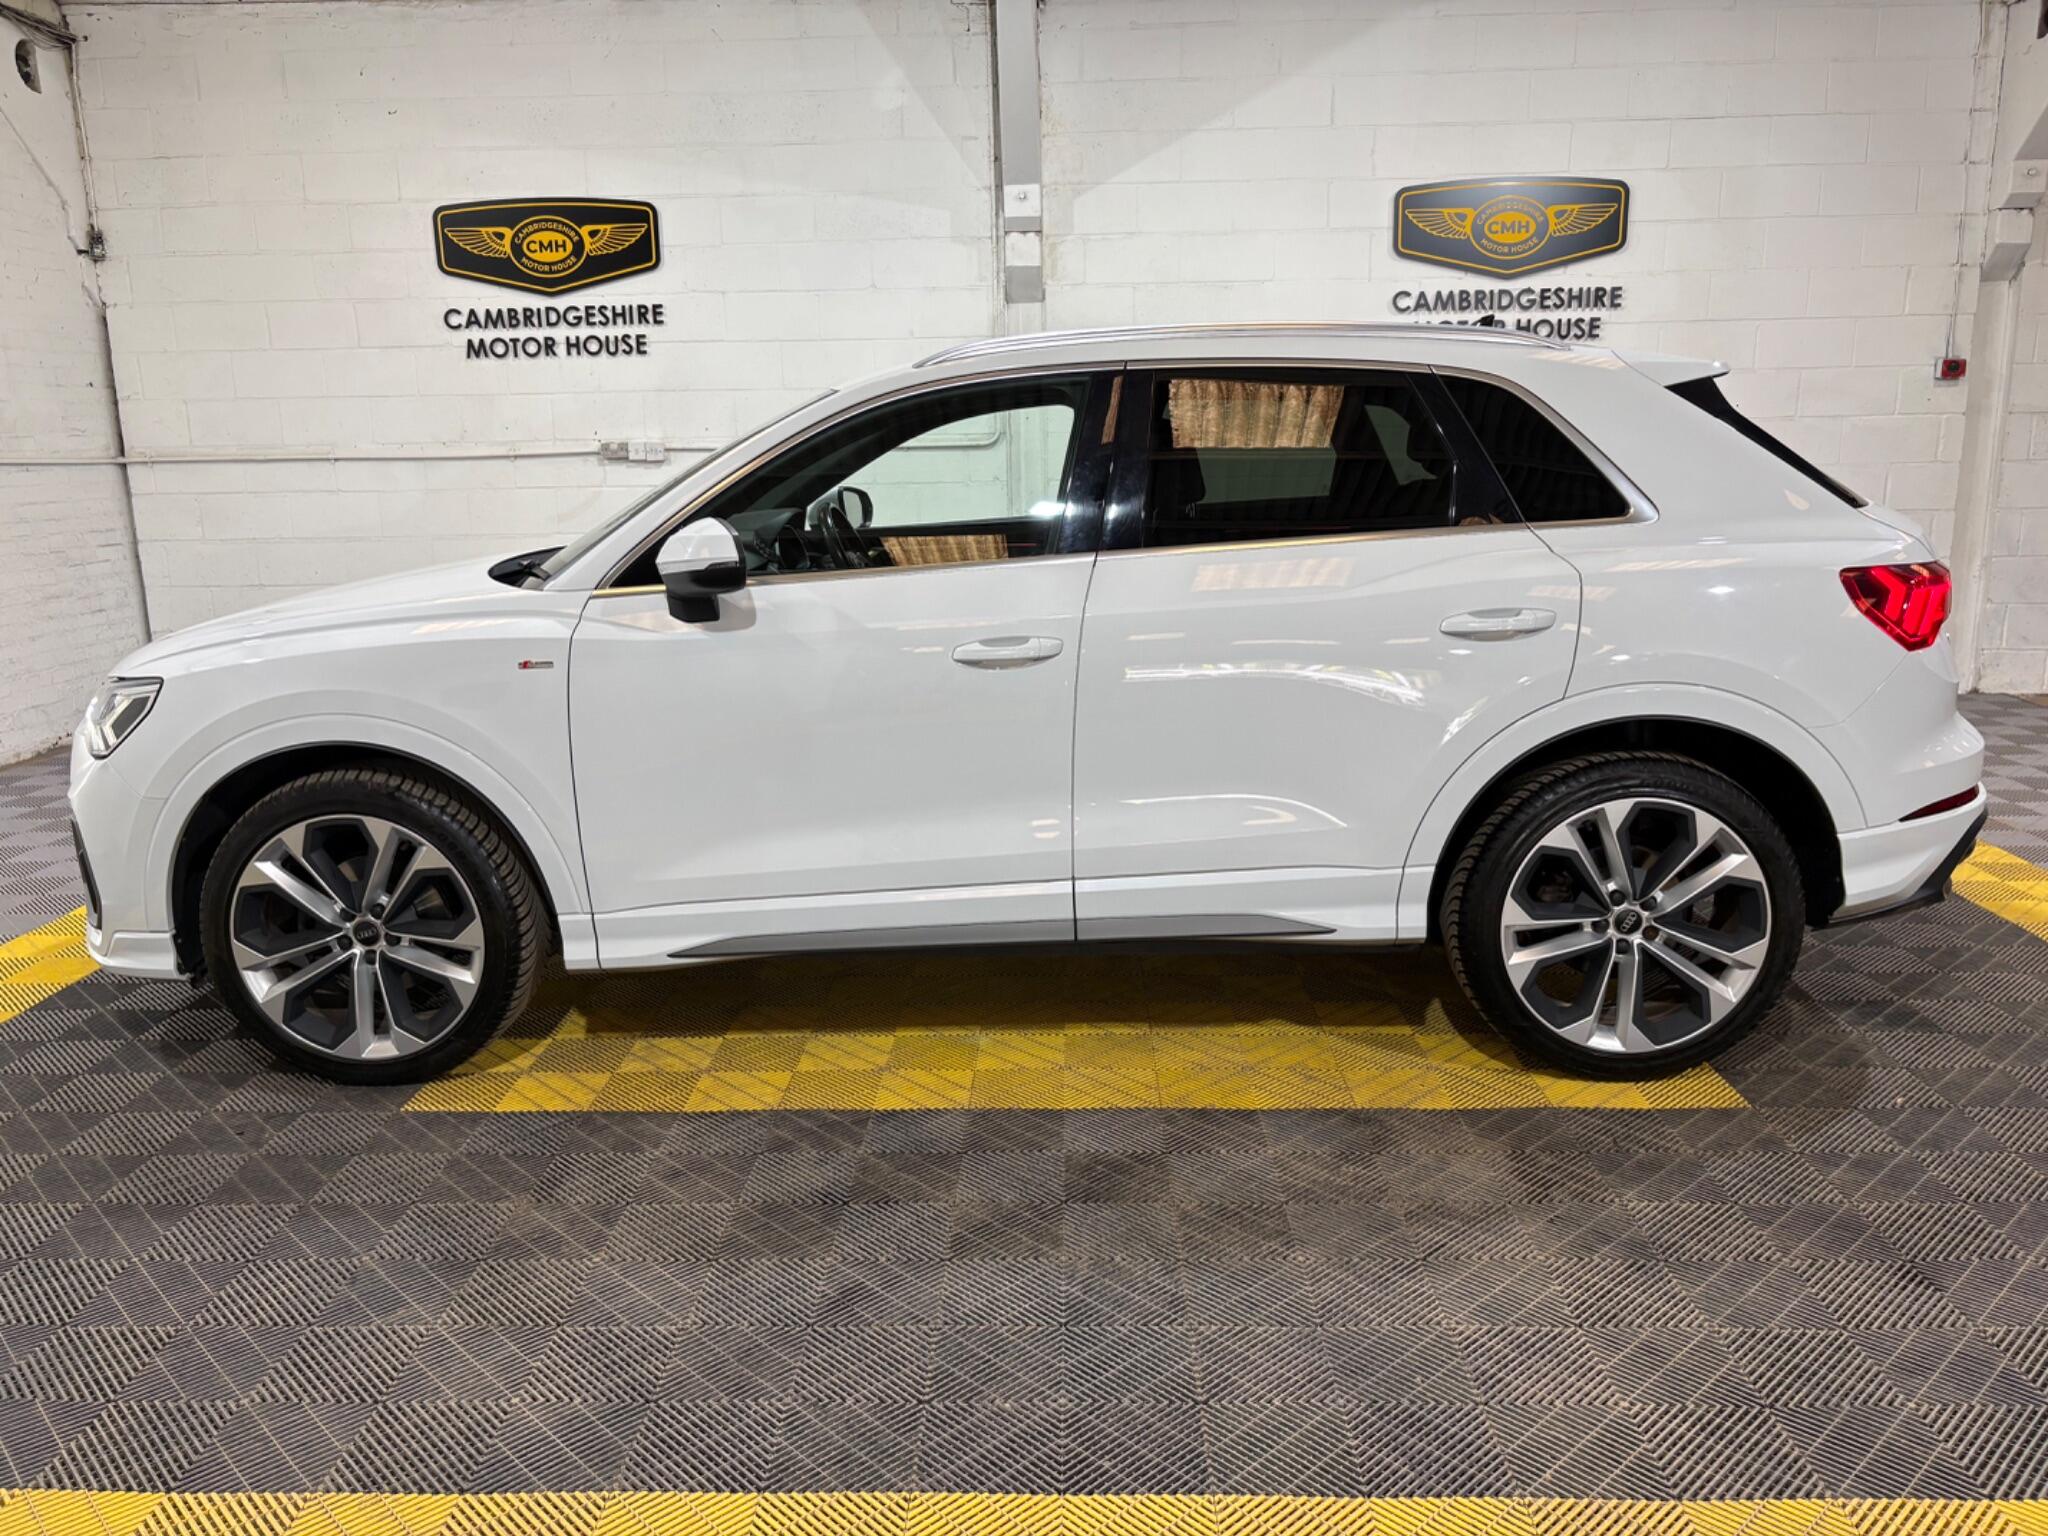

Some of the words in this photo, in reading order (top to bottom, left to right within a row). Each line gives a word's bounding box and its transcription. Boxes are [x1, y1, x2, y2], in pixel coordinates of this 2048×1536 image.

[515, 221, 580, 244] CAMBRIDGESHIRE
[1488, 220, 1530, 234] CMH
[526, 239, 567, 253] CMH
[1480, 238, 1510, 253] MOTOR
[1511, 236, 1539, 253] HOUSE
[521, 256, 550, 272] MOTOR
[551, 255, 578, 272] HOUSE
[1392, 286, 1623, 312] CAMBRIDGESHIRE
[444, 304, 664, 330] CAMBRIDGESHIRE
[466, 336, 557, 359] MOTOR
[566, 334, 648, 356] HOUSE
